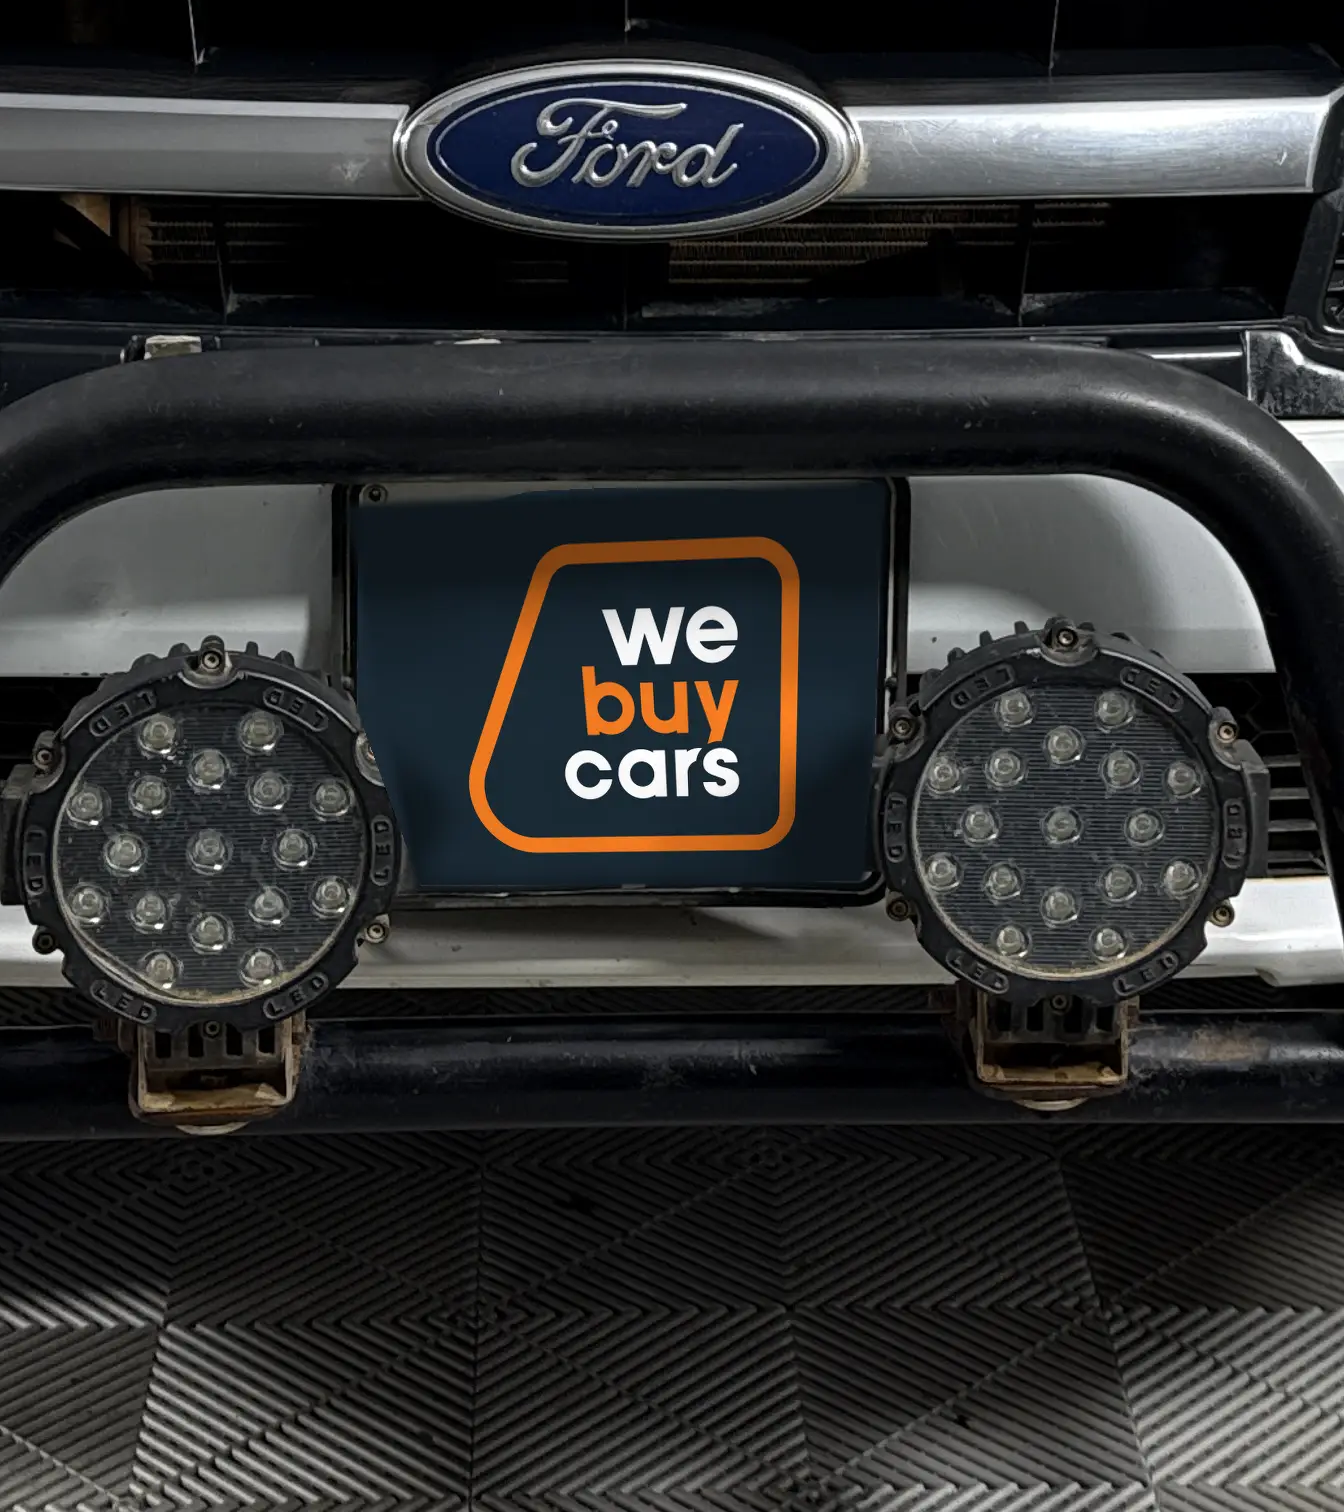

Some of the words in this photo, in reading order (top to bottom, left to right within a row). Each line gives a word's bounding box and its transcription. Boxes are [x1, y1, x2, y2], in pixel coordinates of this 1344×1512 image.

[511, 97, 744, 188] Ford
[94, 693, 153, 732] LED
[267, 690, 325, 728] LED
[374, 822, 390, 881] LED
[888, 799, 905, 859] LED
[270, 973, 324, 1014] LED
